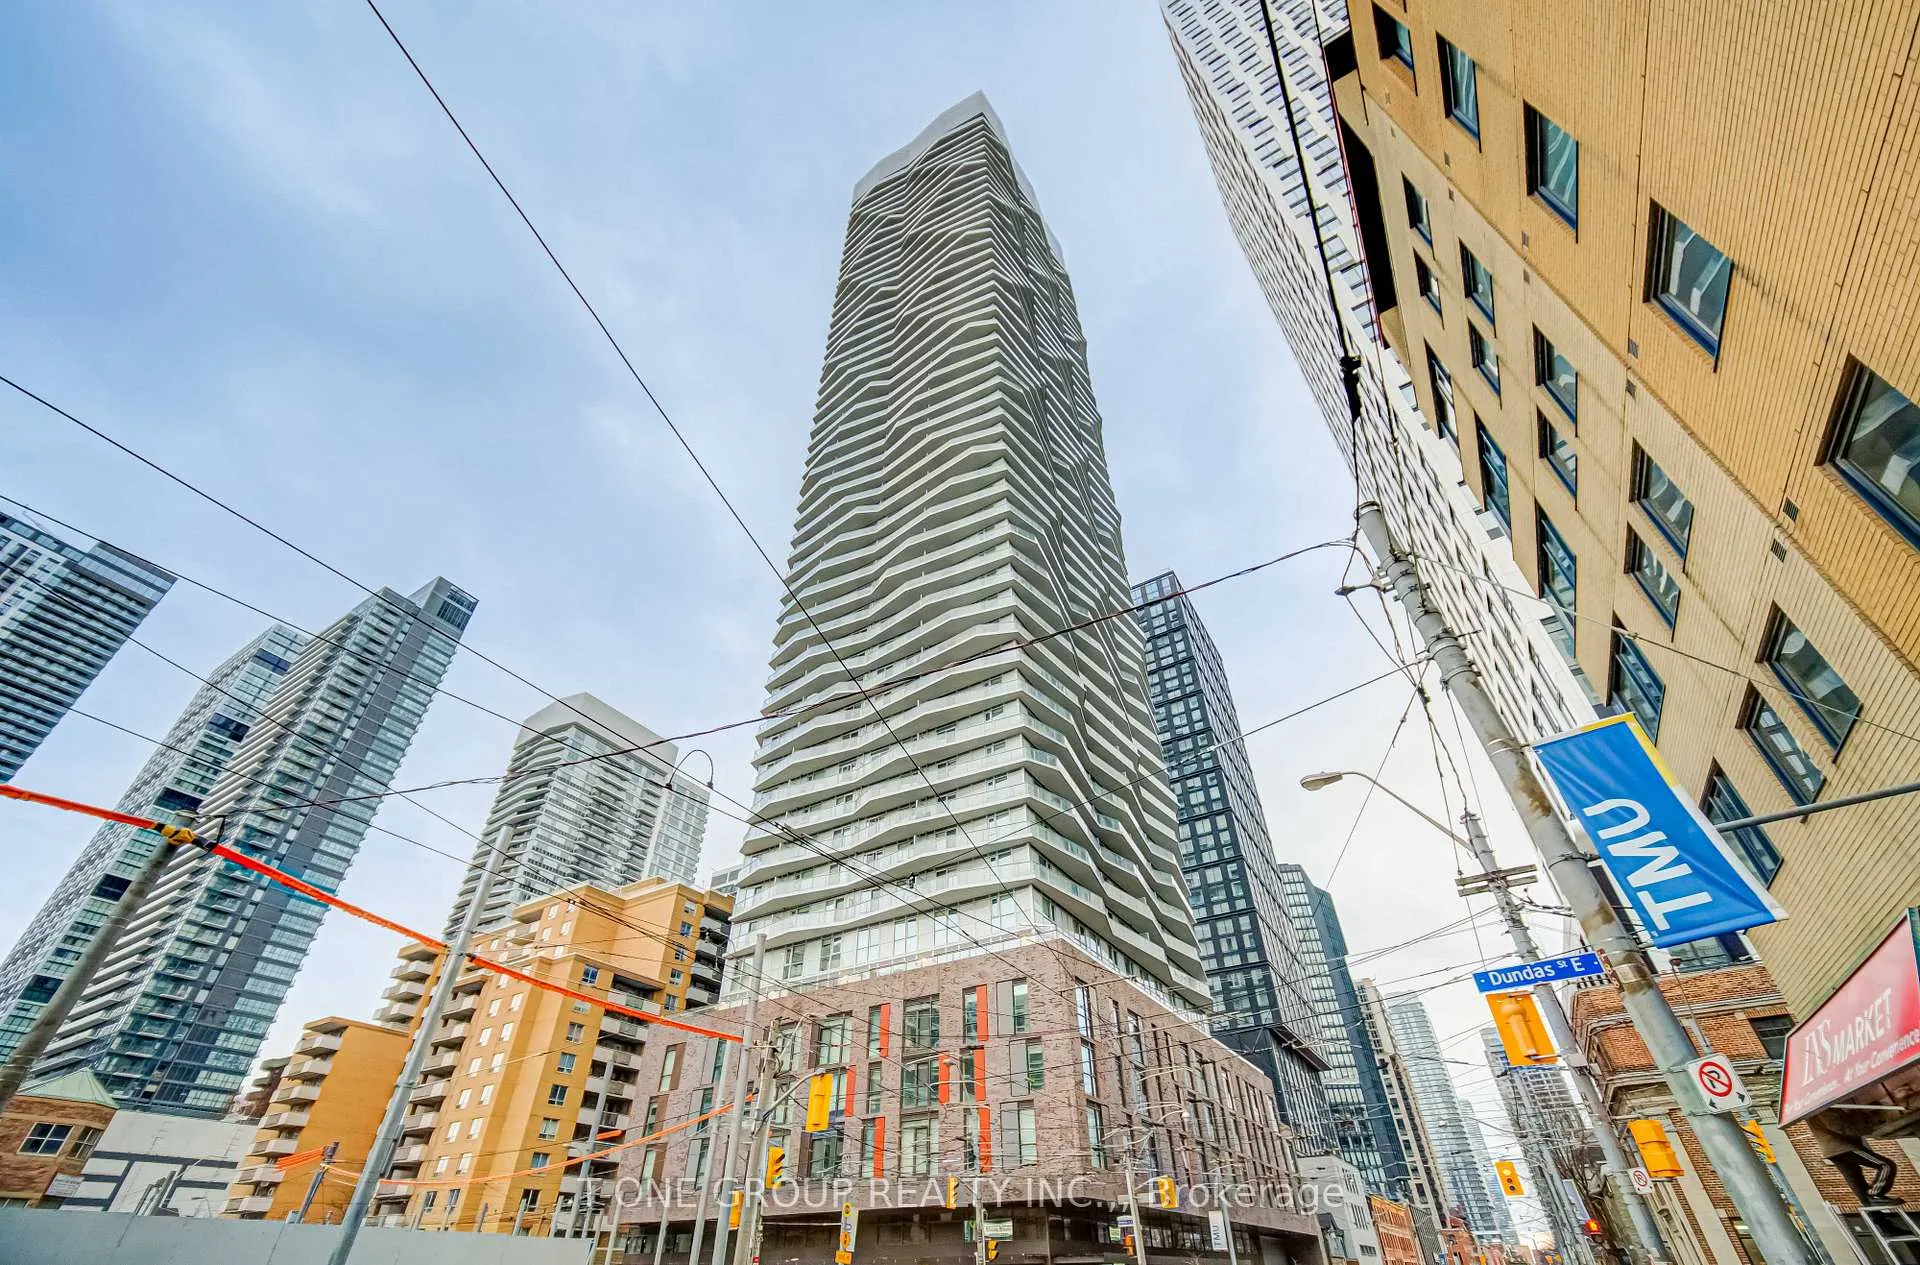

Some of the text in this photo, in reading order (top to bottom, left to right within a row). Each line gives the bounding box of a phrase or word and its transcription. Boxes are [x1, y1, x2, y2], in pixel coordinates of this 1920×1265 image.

[1582, 798, 1713, 931] TMU
[1488, 957, 1585, 986] Dundas St E
[1832, 988, 1892, 1065] MARKET
